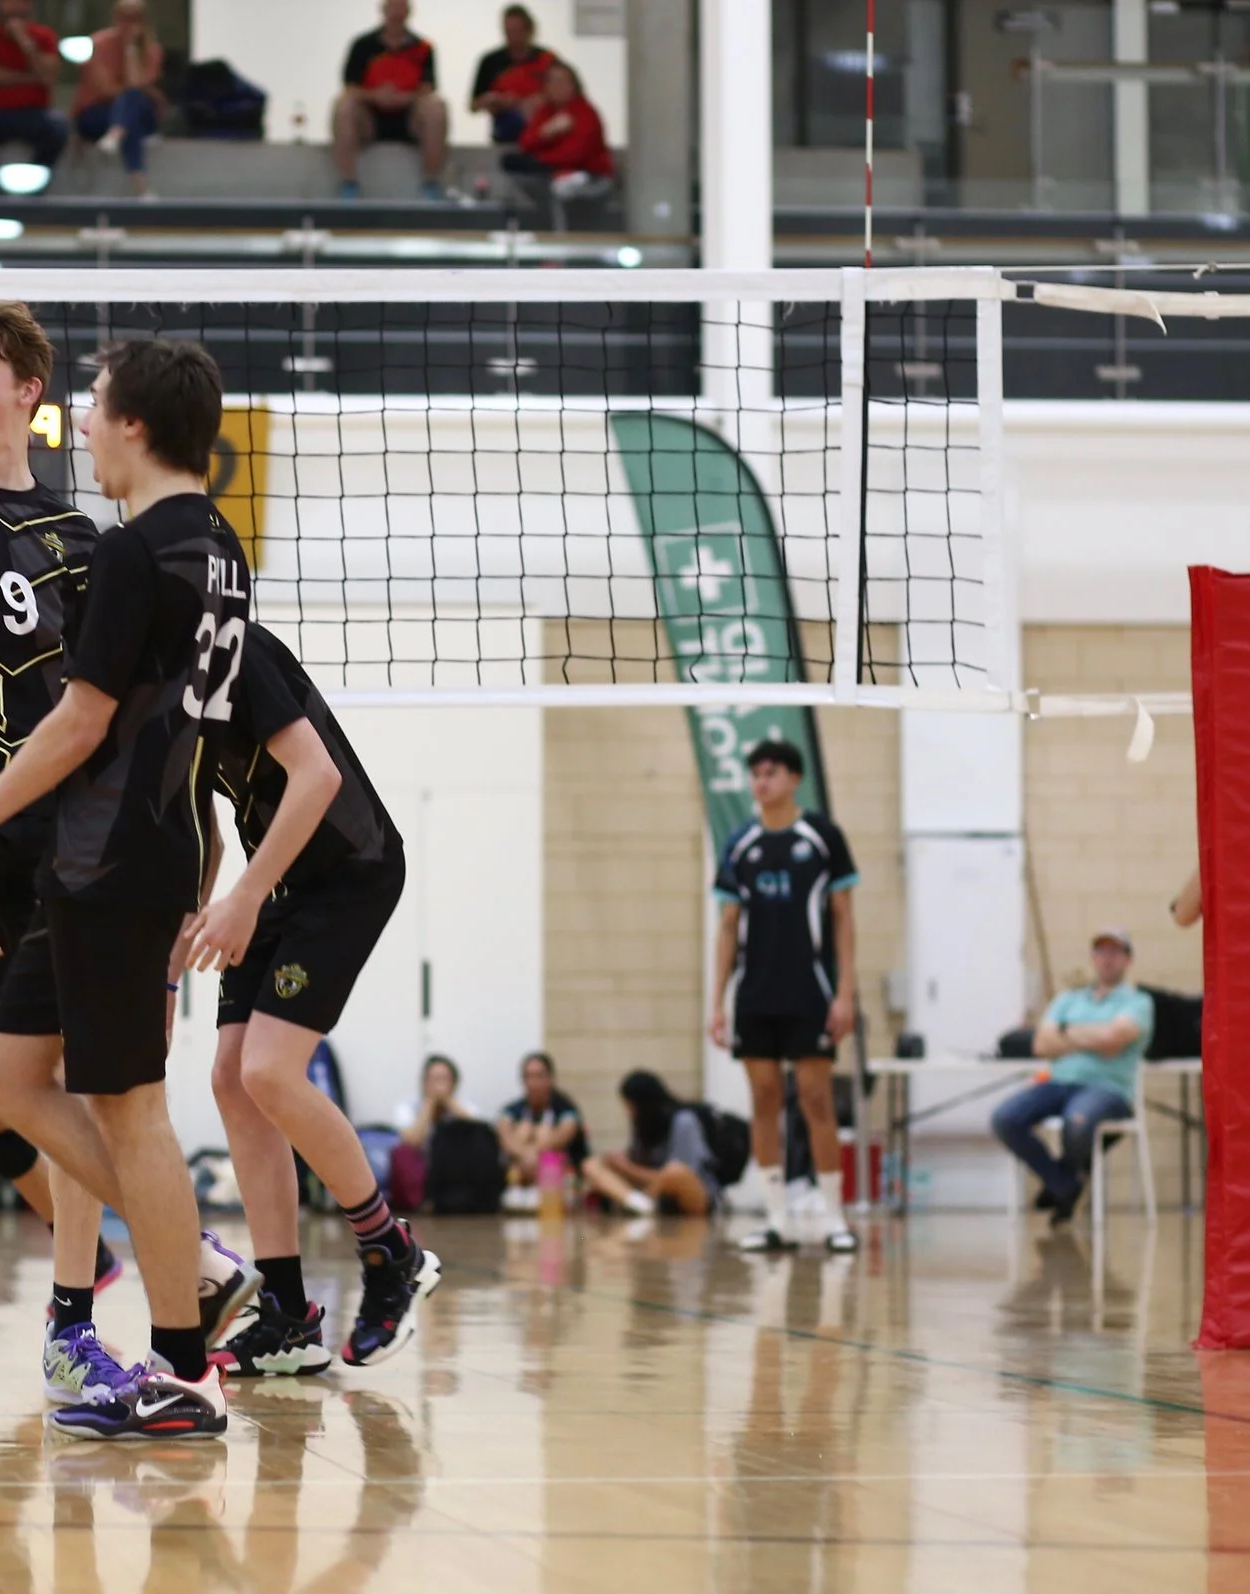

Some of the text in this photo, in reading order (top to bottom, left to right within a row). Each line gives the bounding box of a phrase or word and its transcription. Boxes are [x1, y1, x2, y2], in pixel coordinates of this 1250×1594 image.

[0, 570, 39, 636] 9
[207, 554, 247, 599] PILL
[182, 612, 246, 722] 32
